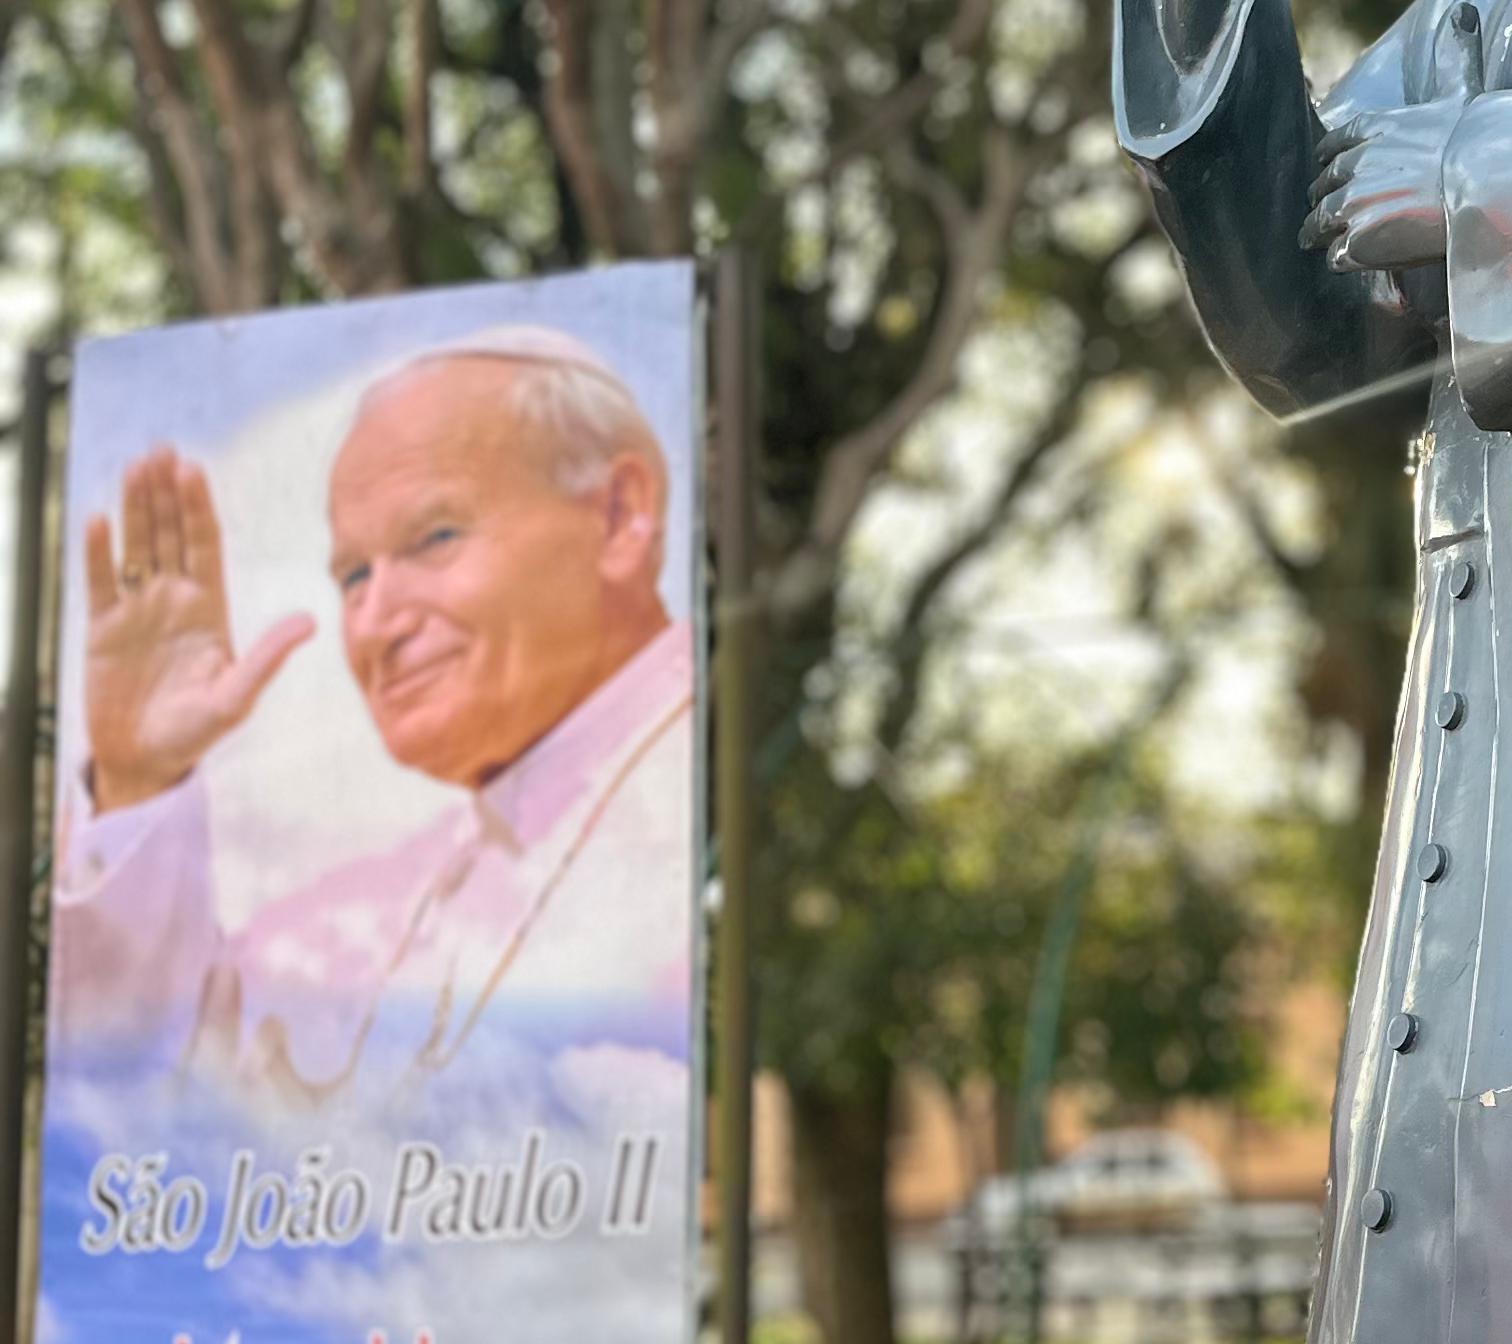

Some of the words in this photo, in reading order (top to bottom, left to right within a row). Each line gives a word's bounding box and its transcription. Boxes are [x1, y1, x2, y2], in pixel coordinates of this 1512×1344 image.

[82, 1152, 207, 1256] São
[204, 1146, 373, 1269] João
[382, 1127, 587, 1245] Paulo
